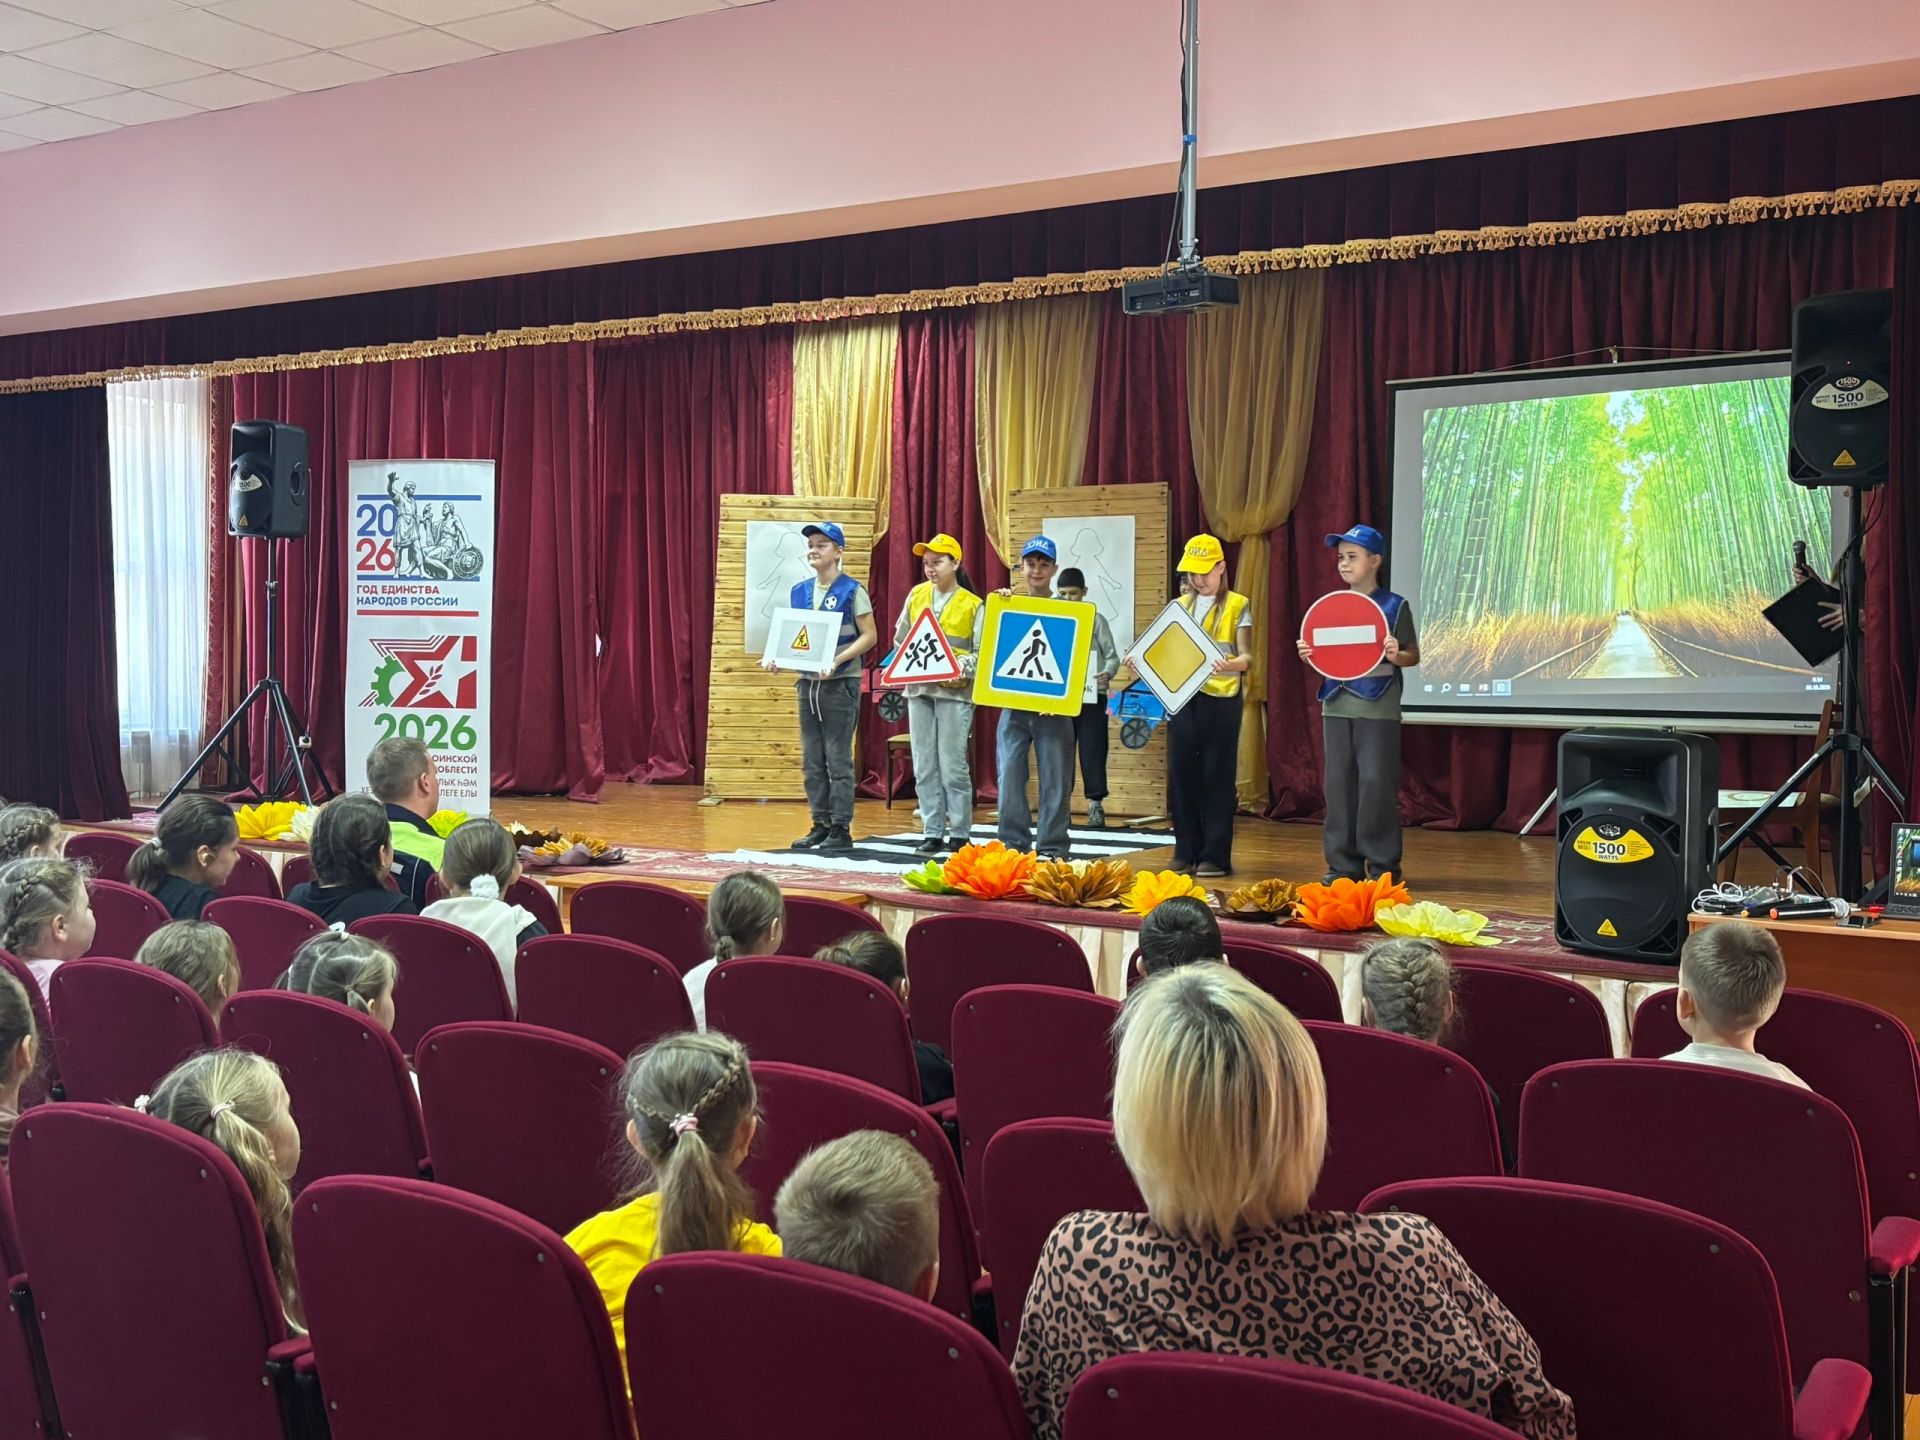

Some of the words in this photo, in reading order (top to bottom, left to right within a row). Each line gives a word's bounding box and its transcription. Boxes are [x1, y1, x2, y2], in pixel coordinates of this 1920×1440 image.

[1832, 392, 1864, 404] 1500
[356, 504, 398, 537] 20
[356, 538, 395, 572] 26
[356, 585, 378, 595] ГОД
[381, 585, 440, 595] ЕДИНСТВА
[356, 596, 408, 607] НАРОДОВ
[410, 597, 459, 607] РОССИИ
[374, 713, 477, 750] 2026
[431, 753, 478, 763] ОИНСКОЙ
[436, 765, 478, 774] ОБЛЕСТИ
[1593, 841, 1626, 855] 1500
